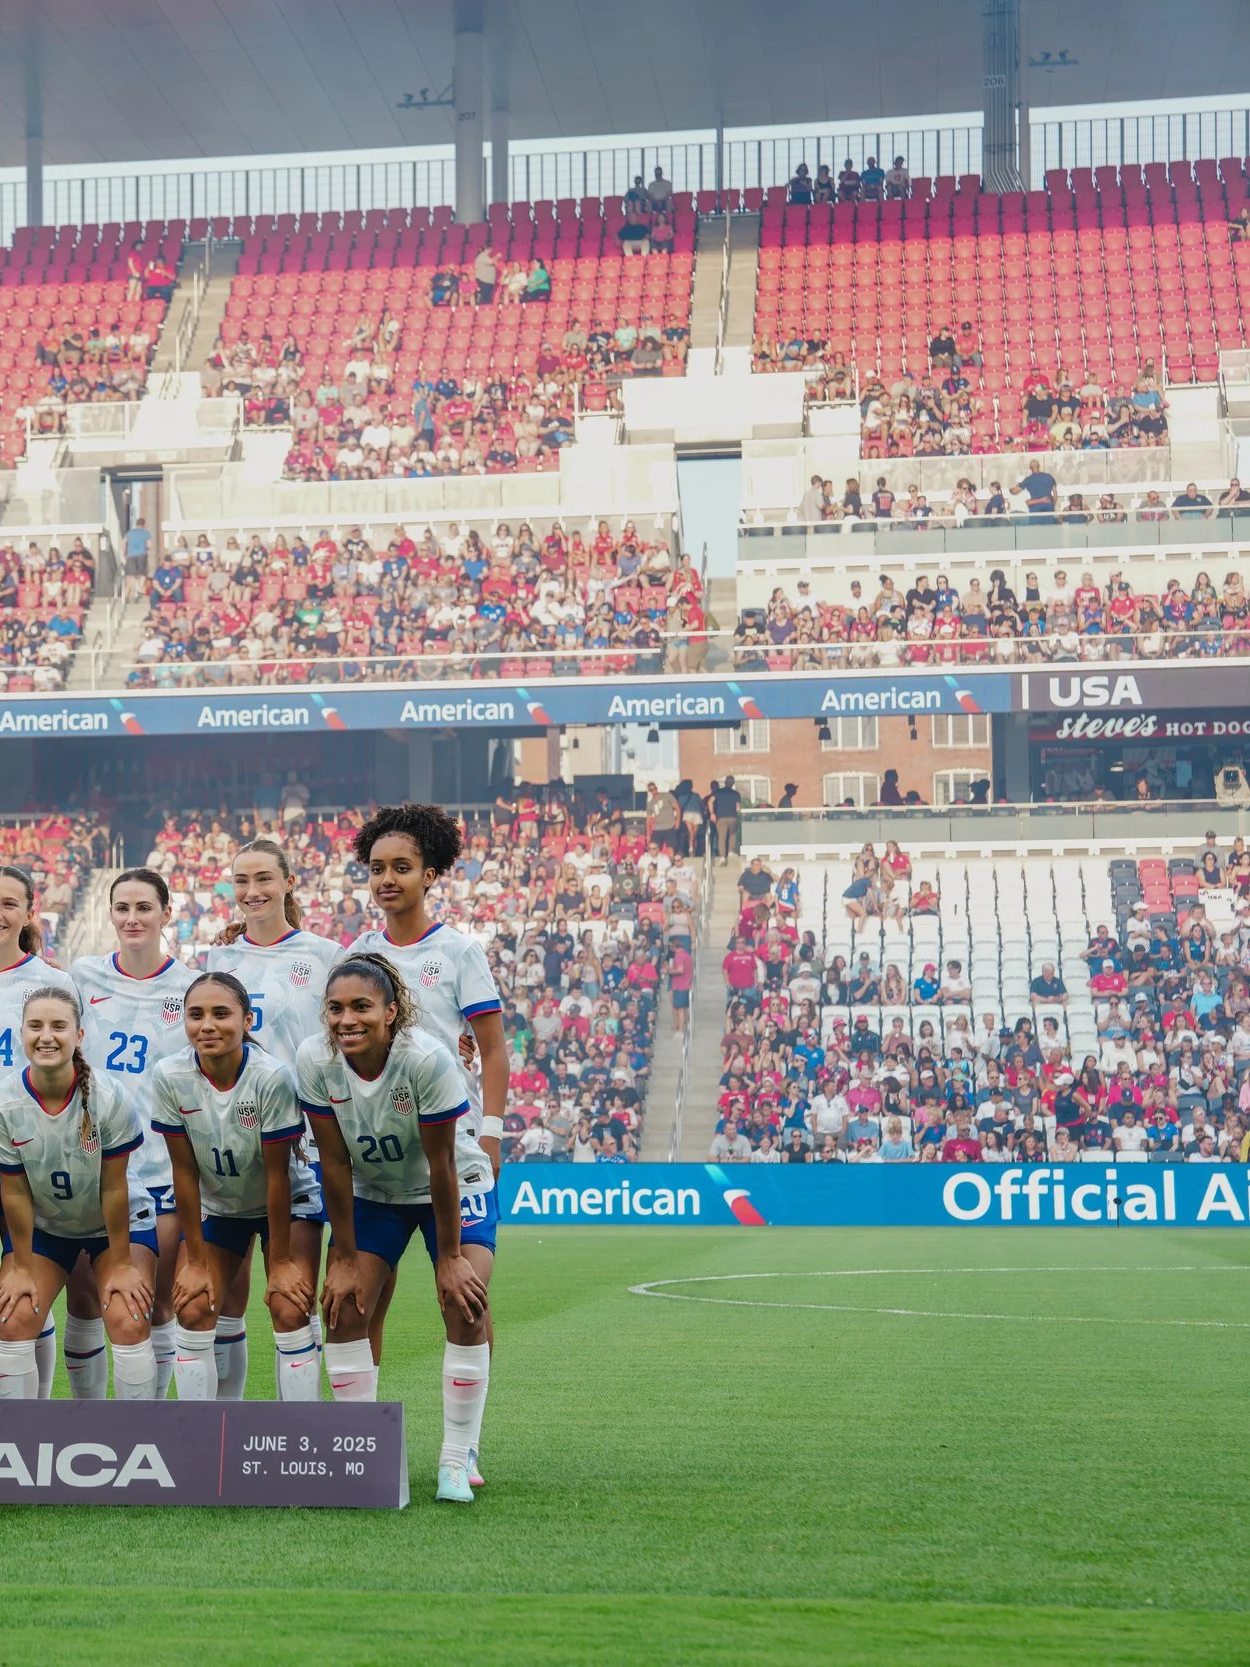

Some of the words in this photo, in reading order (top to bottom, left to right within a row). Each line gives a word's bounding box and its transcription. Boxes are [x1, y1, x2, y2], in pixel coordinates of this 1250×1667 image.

[821, 687, 941, 712] American
[1049, 675, 1143, 707] USA
[198, 705, 310, 728] American
[400, 699, 514, 722] American
[608, 694, 725, 717] American
[1056, 712, 1158, 739] steve's
[1165, 722, 1207, 736] HOT
[293, 965, 310, 977] USA
[423, 966, 440, 977] USA
[164, 1002, 181, 1013] USA
[106, 1031, 148, 1074] 23
[392, 1092, 410, 1103] USA
[238, 1106, 256, 1118] USA
[356, 1134, 405, 1163] 20
[211, 1147, 240, 1177] 11
[50, 1170, 73, 1200] 9
[943, 1168, 1176, 1221] Official
[1196, 1169, 1250, 1221] A
[511, 1180, 700, 1216] American
[243, 1436, 287, 1452] JUNE
[299, 1436, 318, 1454] 3,
[333, 1437, 377, 1453] 2025
[242, 1461, 268, 1475] ST.
[280, 1462, 334, 1477] LOUIS,
[345, 1462, 365, 1476] MO
